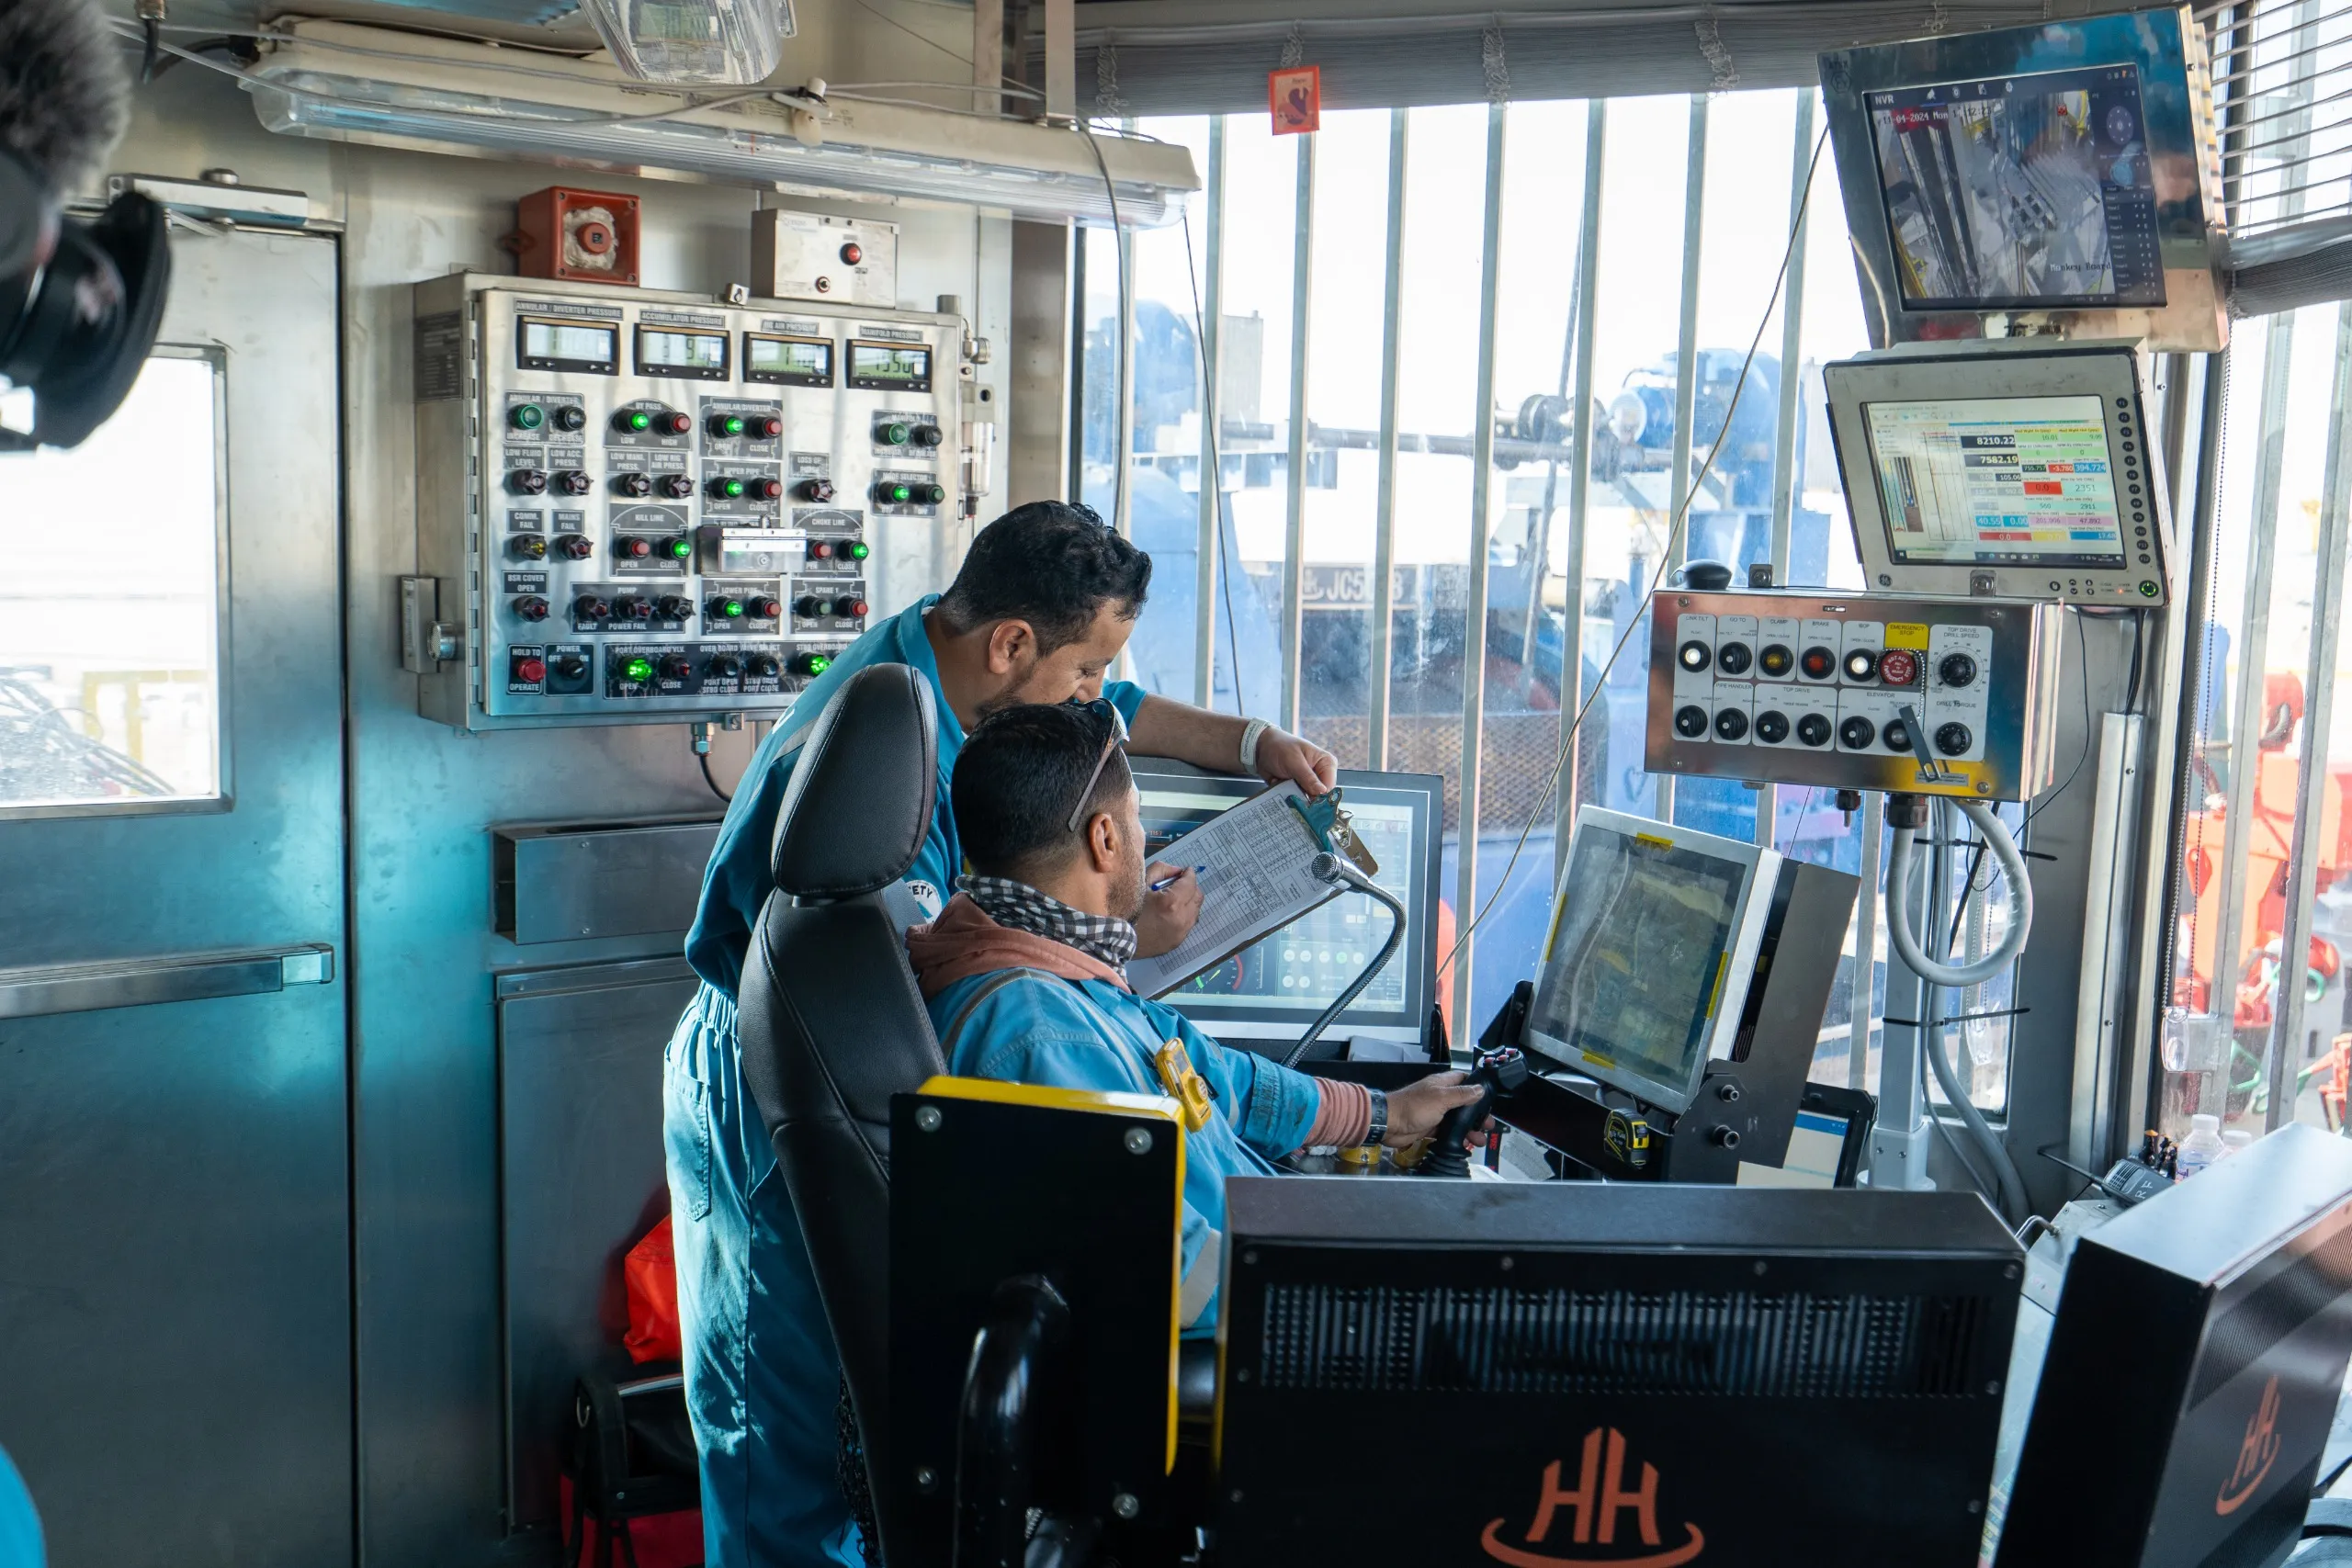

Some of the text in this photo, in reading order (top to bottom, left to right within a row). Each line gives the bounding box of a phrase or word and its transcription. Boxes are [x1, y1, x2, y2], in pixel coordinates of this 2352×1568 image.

[1875, 95, 1894, 105] NVR
[1933, 111, 1949, 120] Mon
[2050, 262, 2111, 273] Monkey Board
[516, 302, 621, 318] ANNULAR DIVERTER PRESSURE
[641, 311, 689, 322] ACCUMULATOR
[662, 438, 677, 446] HIGH
[1976, 436, 2015, 446] 8210.22
[550, 449, 565, 457] LOW
[515, 458, 536, 467] LEVEL
[1980, 456, 2018, 464] 7582.19
[2075, 464, 2106, 472] 394.724
[2035, 483, 2050, 492] 0.0
[2075, 484, 2097, 492] 2351
[749, 503, 768, 512] CLOSE
[559, 513, 581, 522] MAINS
[1978, 517, 2001, 525] 40.55
[2009, 516, 2028, 525] 0.00
[519, 521, 535, 529] FAIL
[561, 522, 576, 530] FAIL
[660, 561, 680, 570] CLOSE
[522, 574, 545, 582] COVER
[517, 584, 536, 592] OPEN
[578, 623, 597, 631] FAULT
[749, 622, 767, 630] CLOSE
[616, 646, 631, 654] PORT
[632, 646, 669, 654] OVERBOARD
[718, 644, 738, 652] BOARD
[509, 683, 540, 692] OPERATE
[908, 885, 933, 898] ETY
